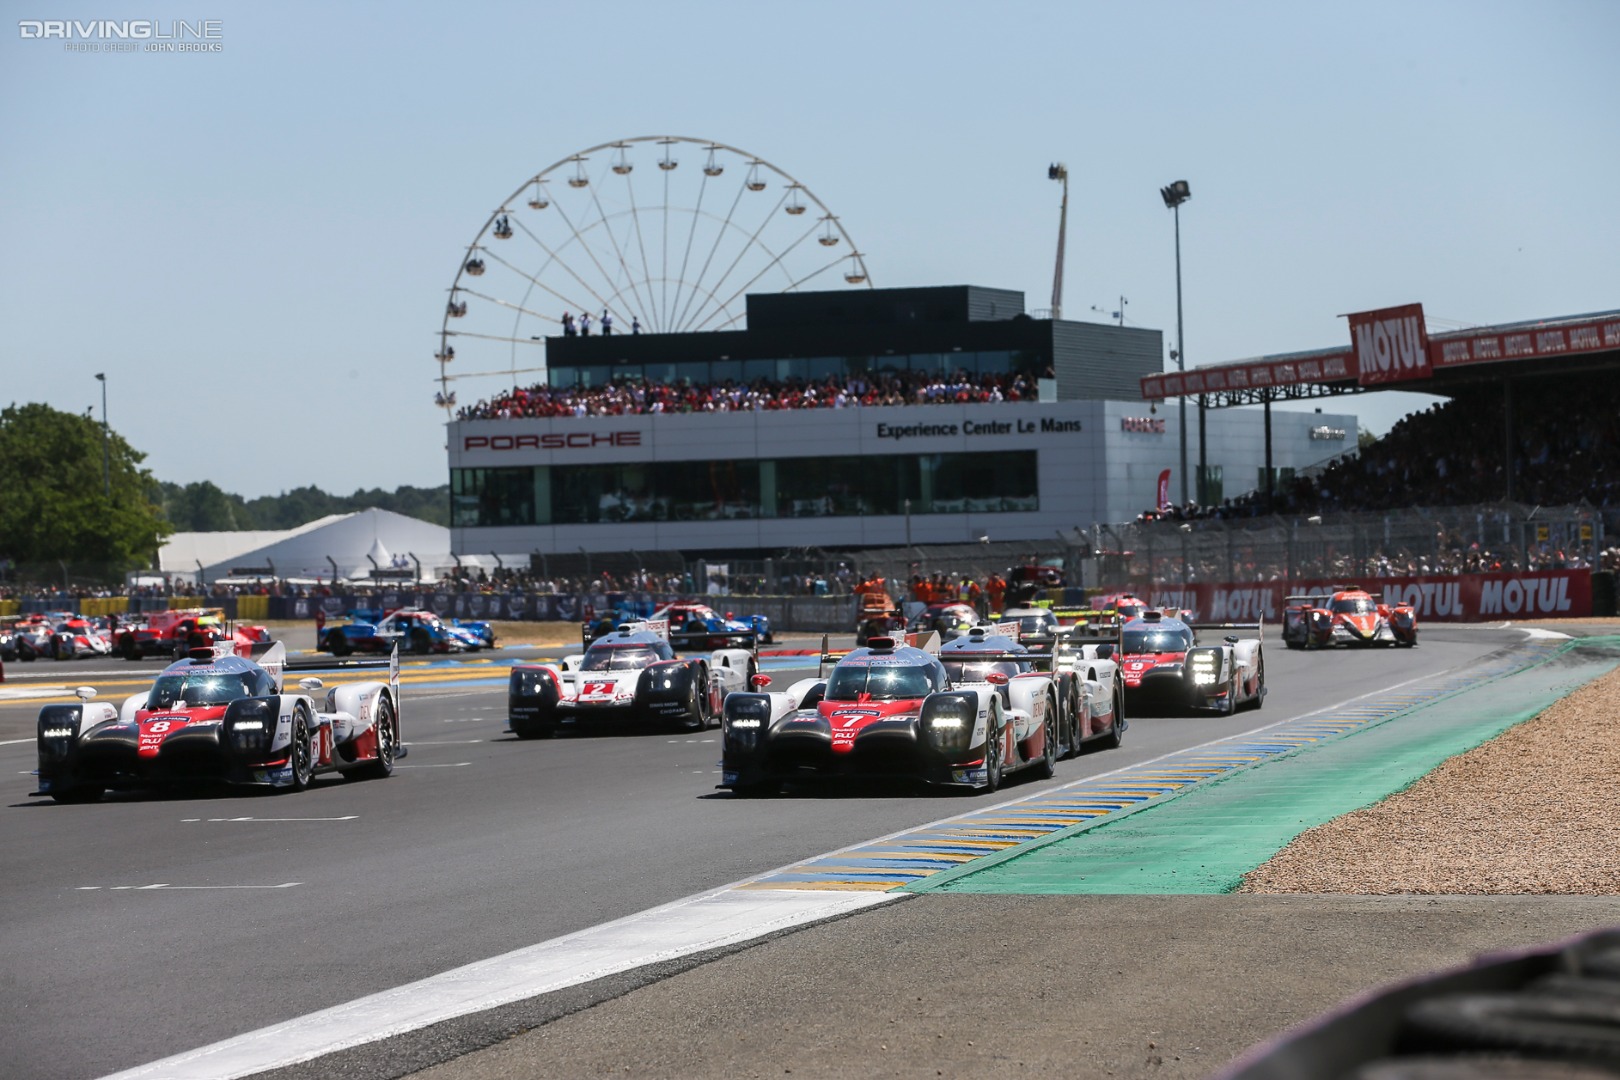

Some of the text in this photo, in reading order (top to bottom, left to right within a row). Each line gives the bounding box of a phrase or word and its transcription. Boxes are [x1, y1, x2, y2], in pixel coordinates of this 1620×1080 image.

[1356, 315, 1427, 374] MOTUL
[877, 417, 1082, 440] Experience Center Le Mans
[464, 431, 642, 452] PORSCHE
[1210, 588, 1275, 620] MOTUL
[1479, 576, 1572, 615] MOTUL
[1131, 662, 1143, 671] 9
[590, 683, 606, 695] 2
[150, 721, 171, 733] 8
[843, 715, 863, 728] 7
